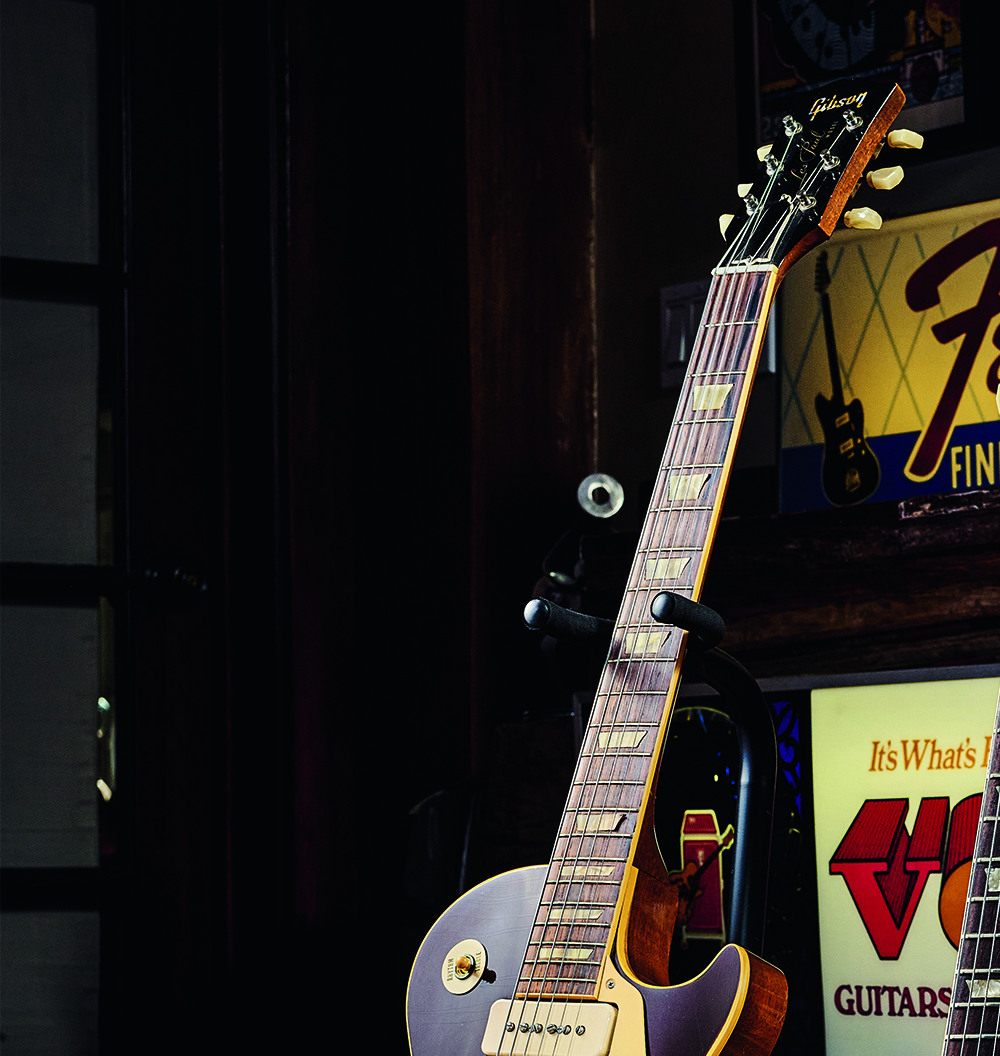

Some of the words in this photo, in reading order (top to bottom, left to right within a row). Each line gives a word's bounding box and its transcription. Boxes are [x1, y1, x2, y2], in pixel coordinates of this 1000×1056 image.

[808, 91, 868, 122] Gibson
[868, 740, 898, 772] It's
[901, 737, 977, 771] What's
[833, 984, 952, 1018] GUITARS
